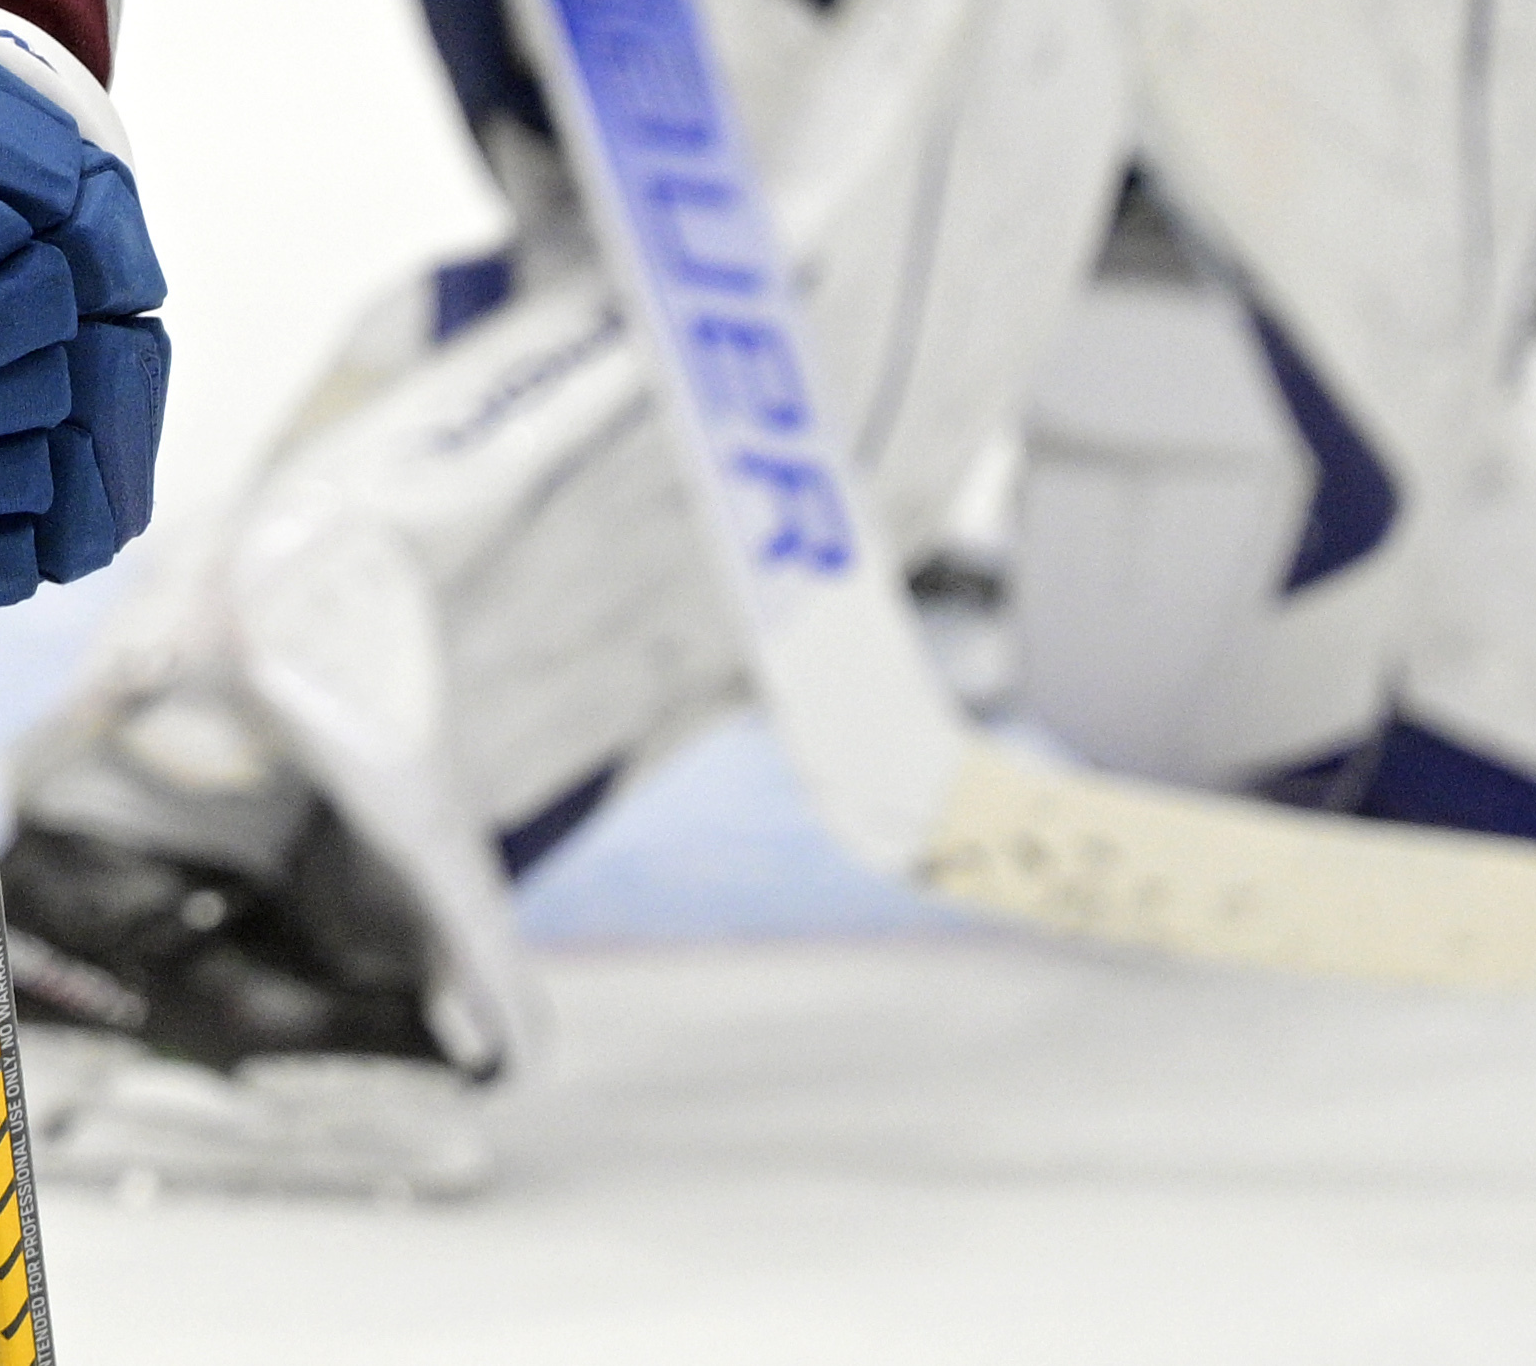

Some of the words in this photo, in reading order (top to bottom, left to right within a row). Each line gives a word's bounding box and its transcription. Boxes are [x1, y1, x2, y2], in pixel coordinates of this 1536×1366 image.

[0, 1023, 14, 1050] NO
[9, 1101, 24, 1132] USE
[13, 1132, 39, 1259] PROFESSIONAL
[27, 1256, 44, 1294] FOR
[31, 1296, 52, 1366] NTENDED
